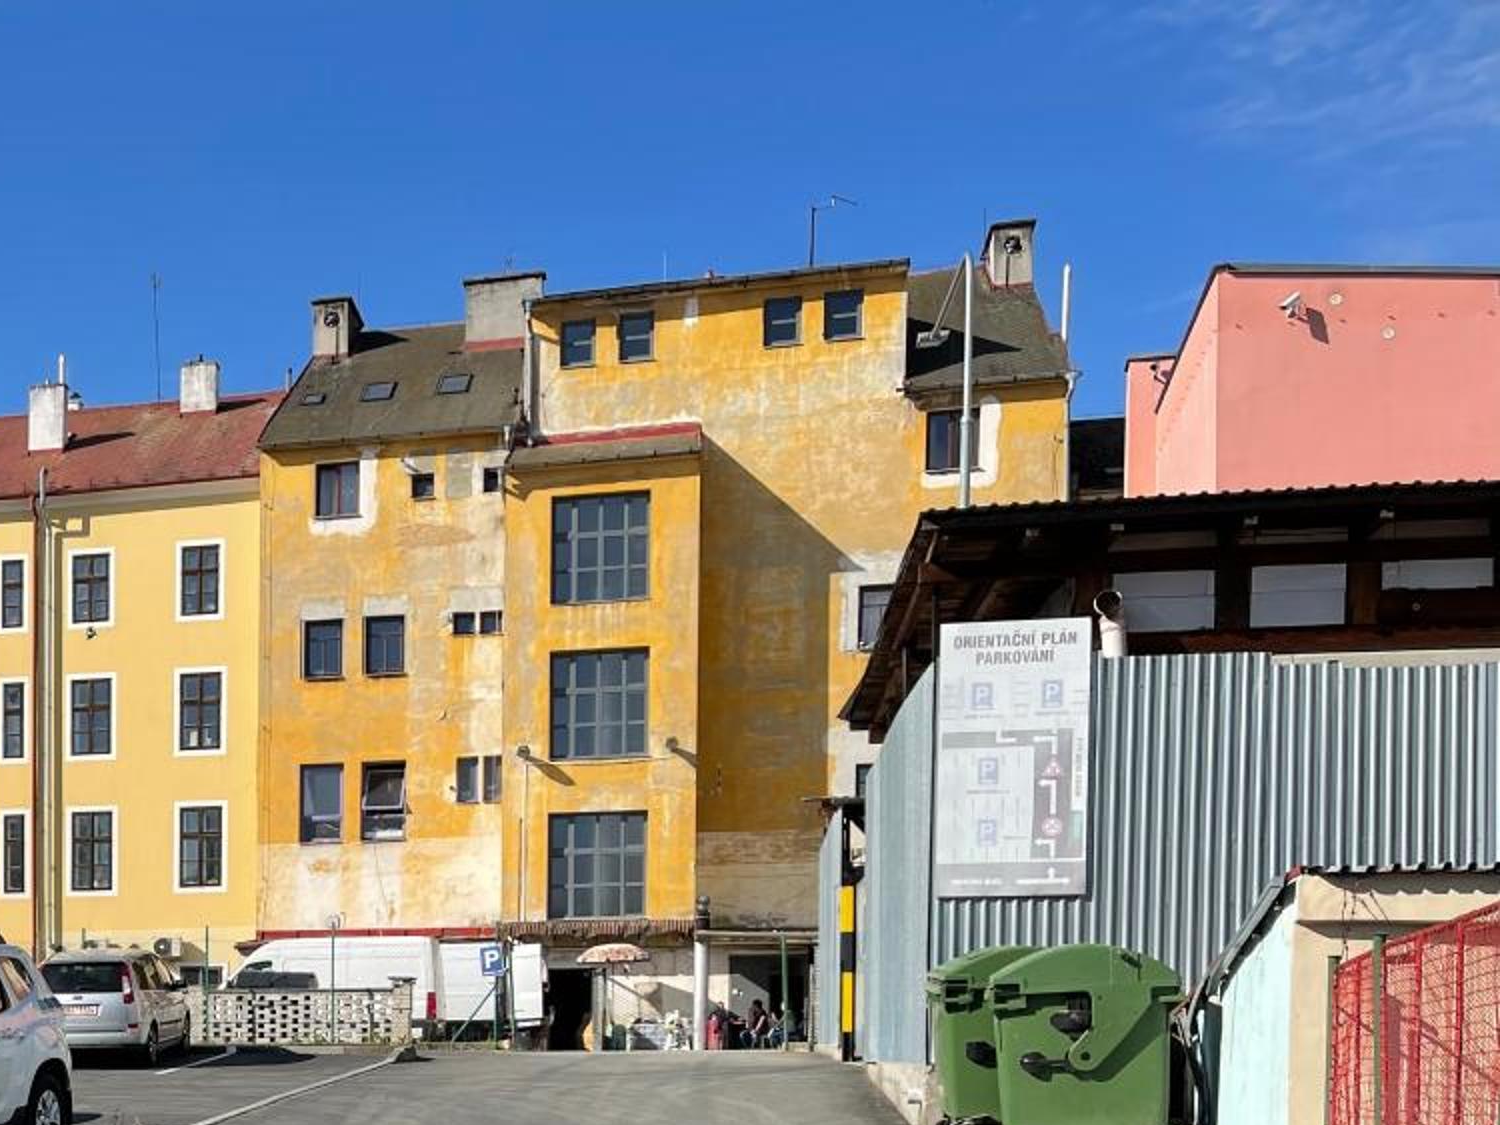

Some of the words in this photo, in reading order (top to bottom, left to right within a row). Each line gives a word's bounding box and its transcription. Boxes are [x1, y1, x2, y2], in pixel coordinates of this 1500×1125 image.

[953, 630, 1036, 649] ORIENTAČNÍ
[1041, 628, 1078, 645] PLÁN
[975, 649, 1055, 665] PARKOVÁNÍ
[485, 950, 499, 969] P
